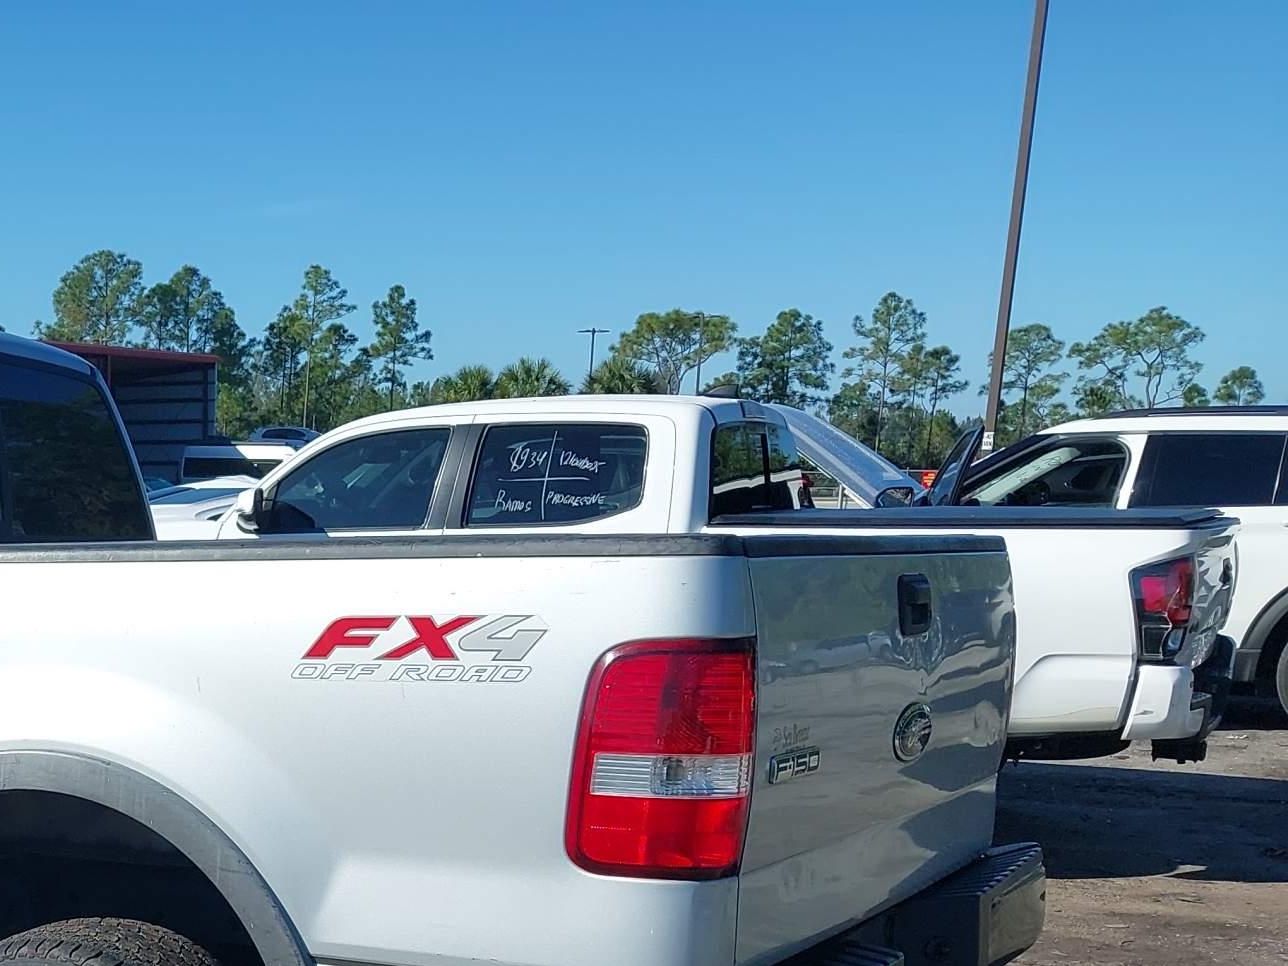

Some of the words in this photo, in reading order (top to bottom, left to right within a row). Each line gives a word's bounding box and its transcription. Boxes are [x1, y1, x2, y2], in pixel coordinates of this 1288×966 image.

[300, 614, 549, 661] FX4
[290, 663, 382, 680] OFF
[389, 664, 532, 683] ROAD
